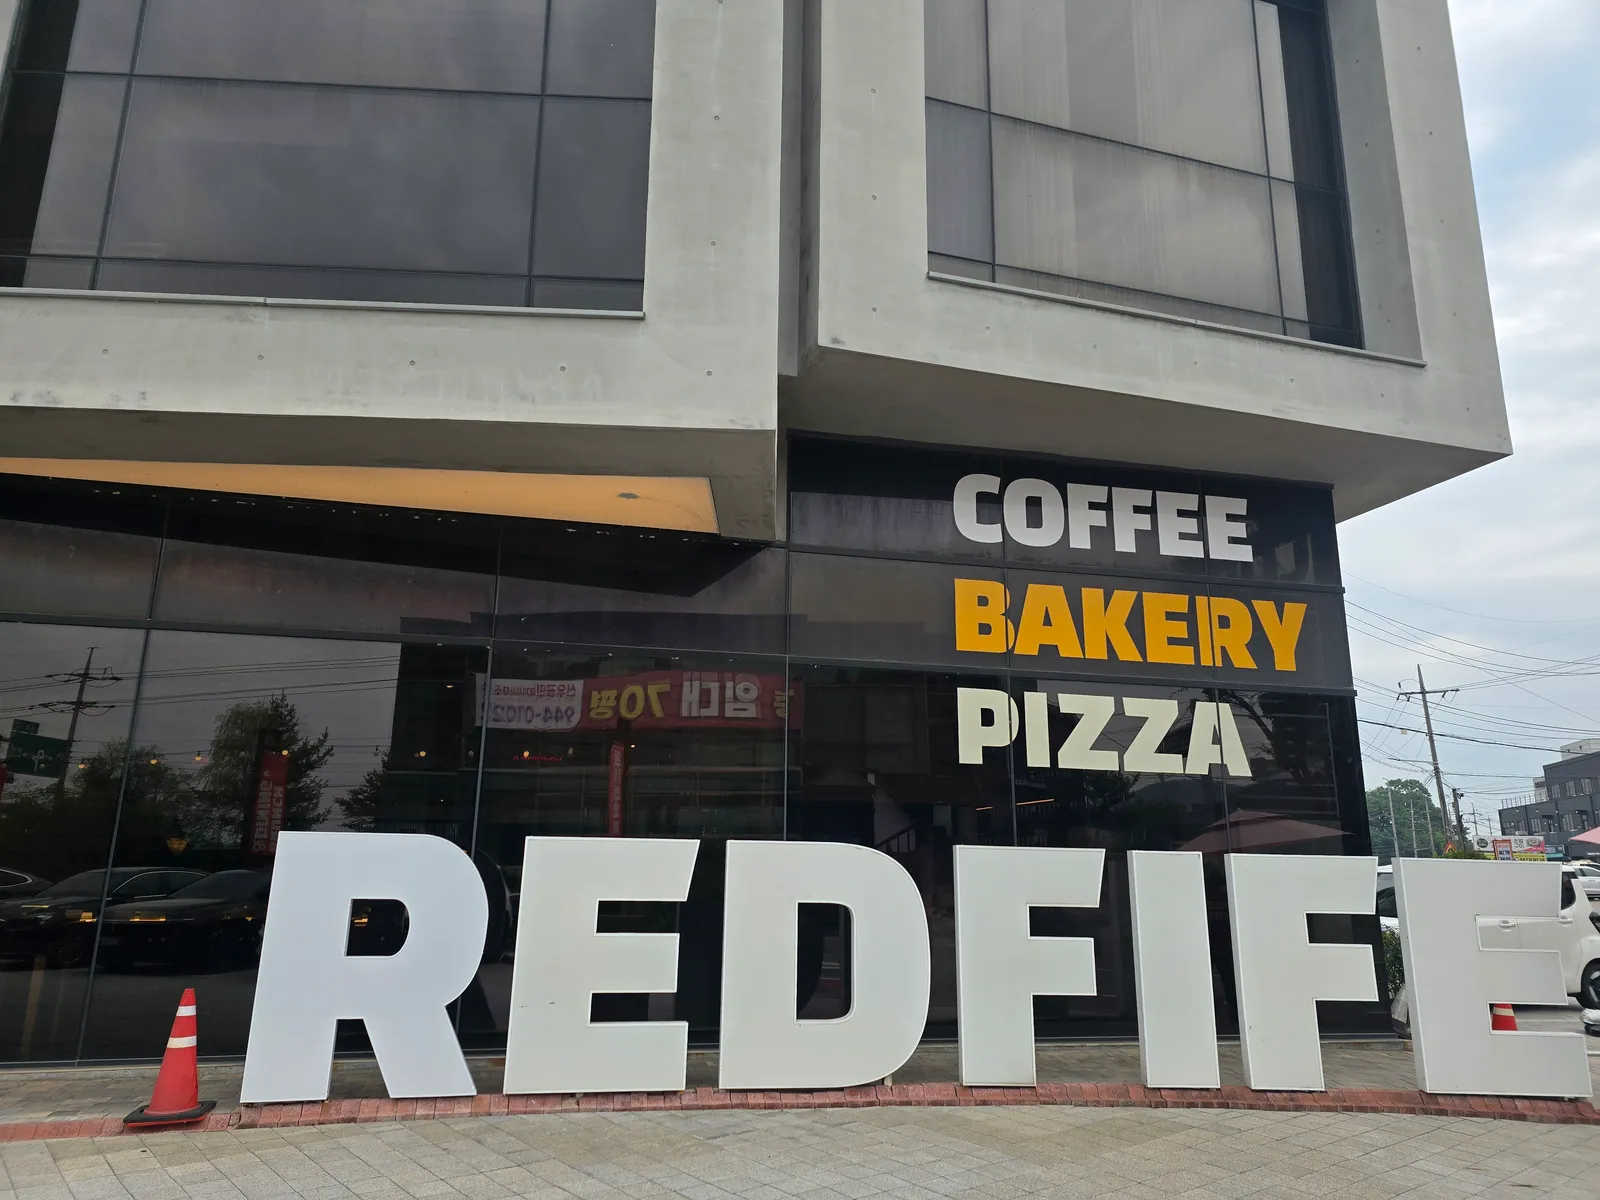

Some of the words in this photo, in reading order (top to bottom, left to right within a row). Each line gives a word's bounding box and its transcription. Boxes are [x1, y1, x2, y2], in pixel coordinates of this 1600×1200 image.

[953, 473, 1254, 562] COFFEE
[954, 578, 1307, 672] BAKERY
[956, 687, 1253, 777] PIZZA
